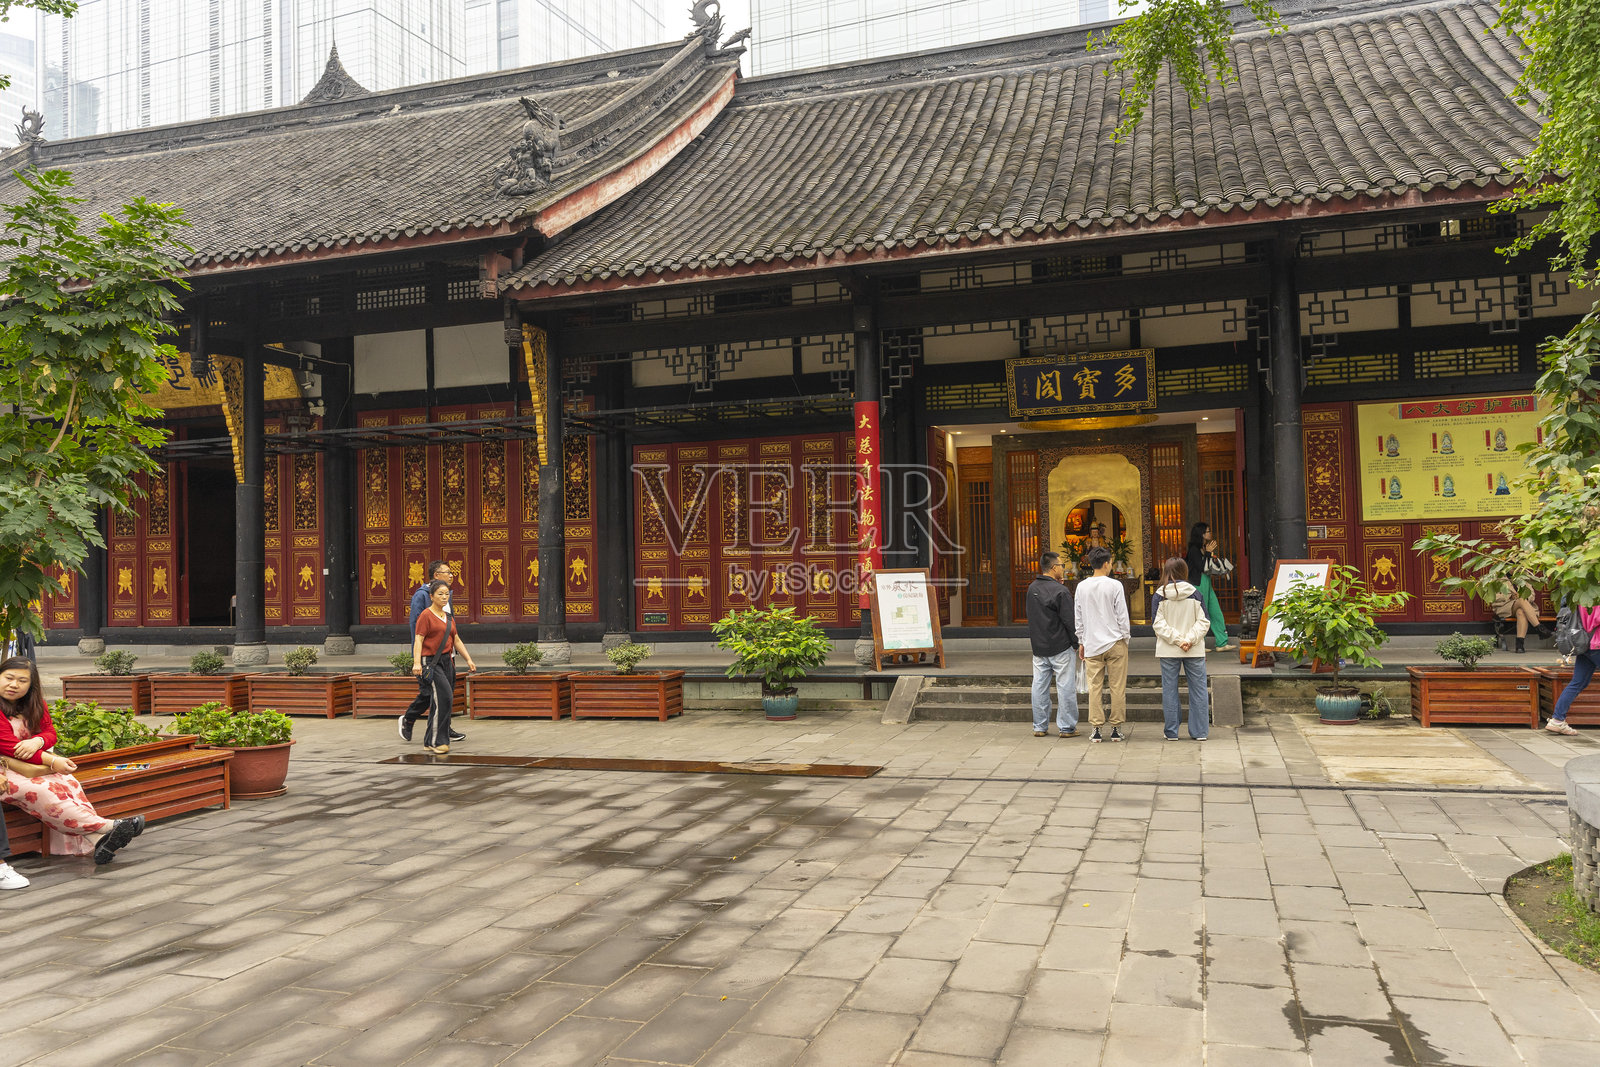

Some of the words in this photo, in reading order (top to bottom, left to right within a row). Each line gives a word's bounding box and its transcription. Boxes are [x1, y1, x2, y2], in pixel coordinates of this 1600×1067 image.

[1406, 397, 1530, 415] 八大守护神
